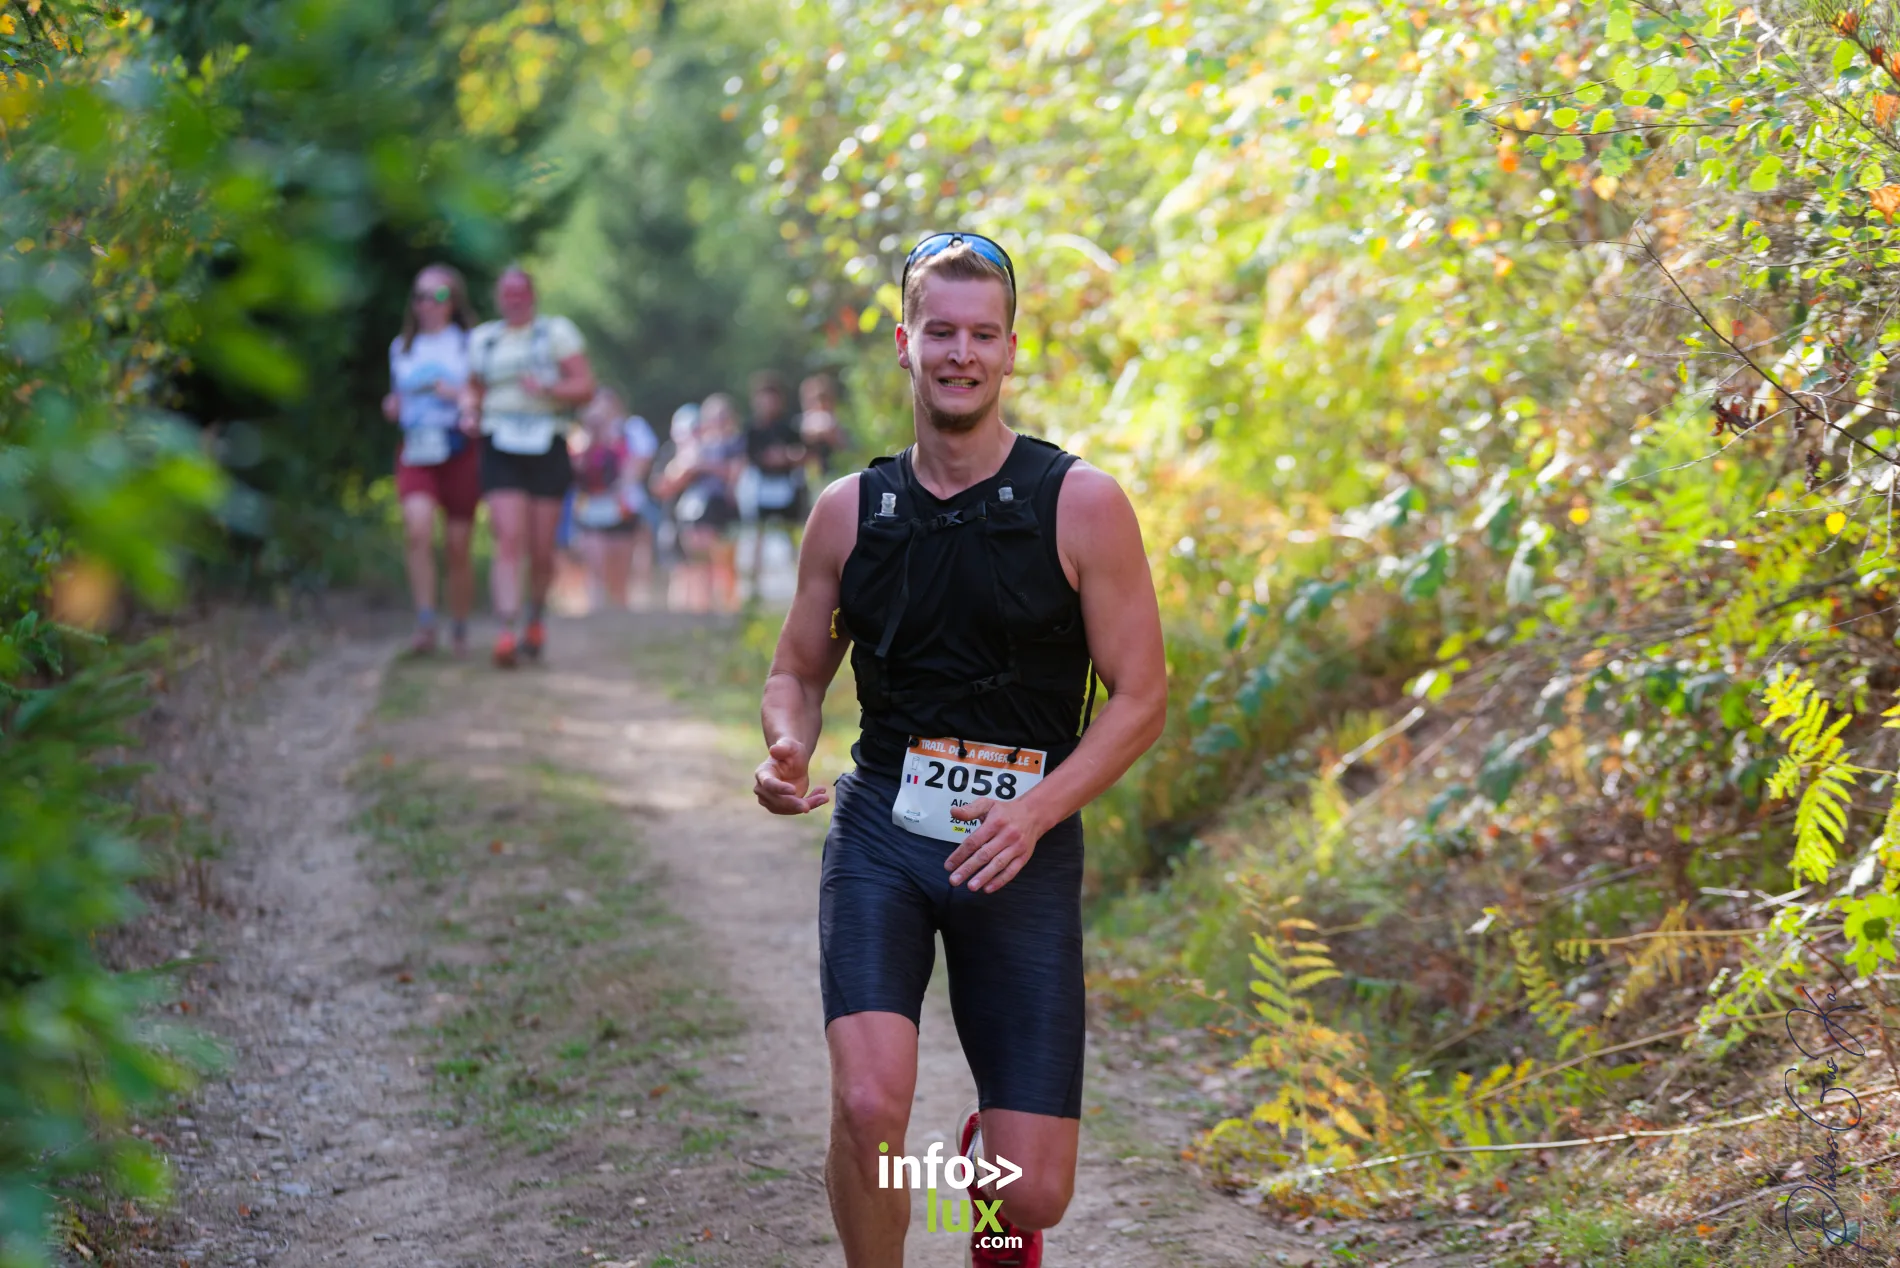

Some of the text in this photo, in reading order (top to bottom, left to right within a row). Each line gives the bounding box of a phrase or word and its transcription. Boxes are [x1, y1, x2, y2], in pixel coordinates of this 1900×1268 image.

[921, 739, 946, 753] TRAIL
[977, 750, 1031, 766] PASSERLE
[925, 761, 1017, 800] 2058
